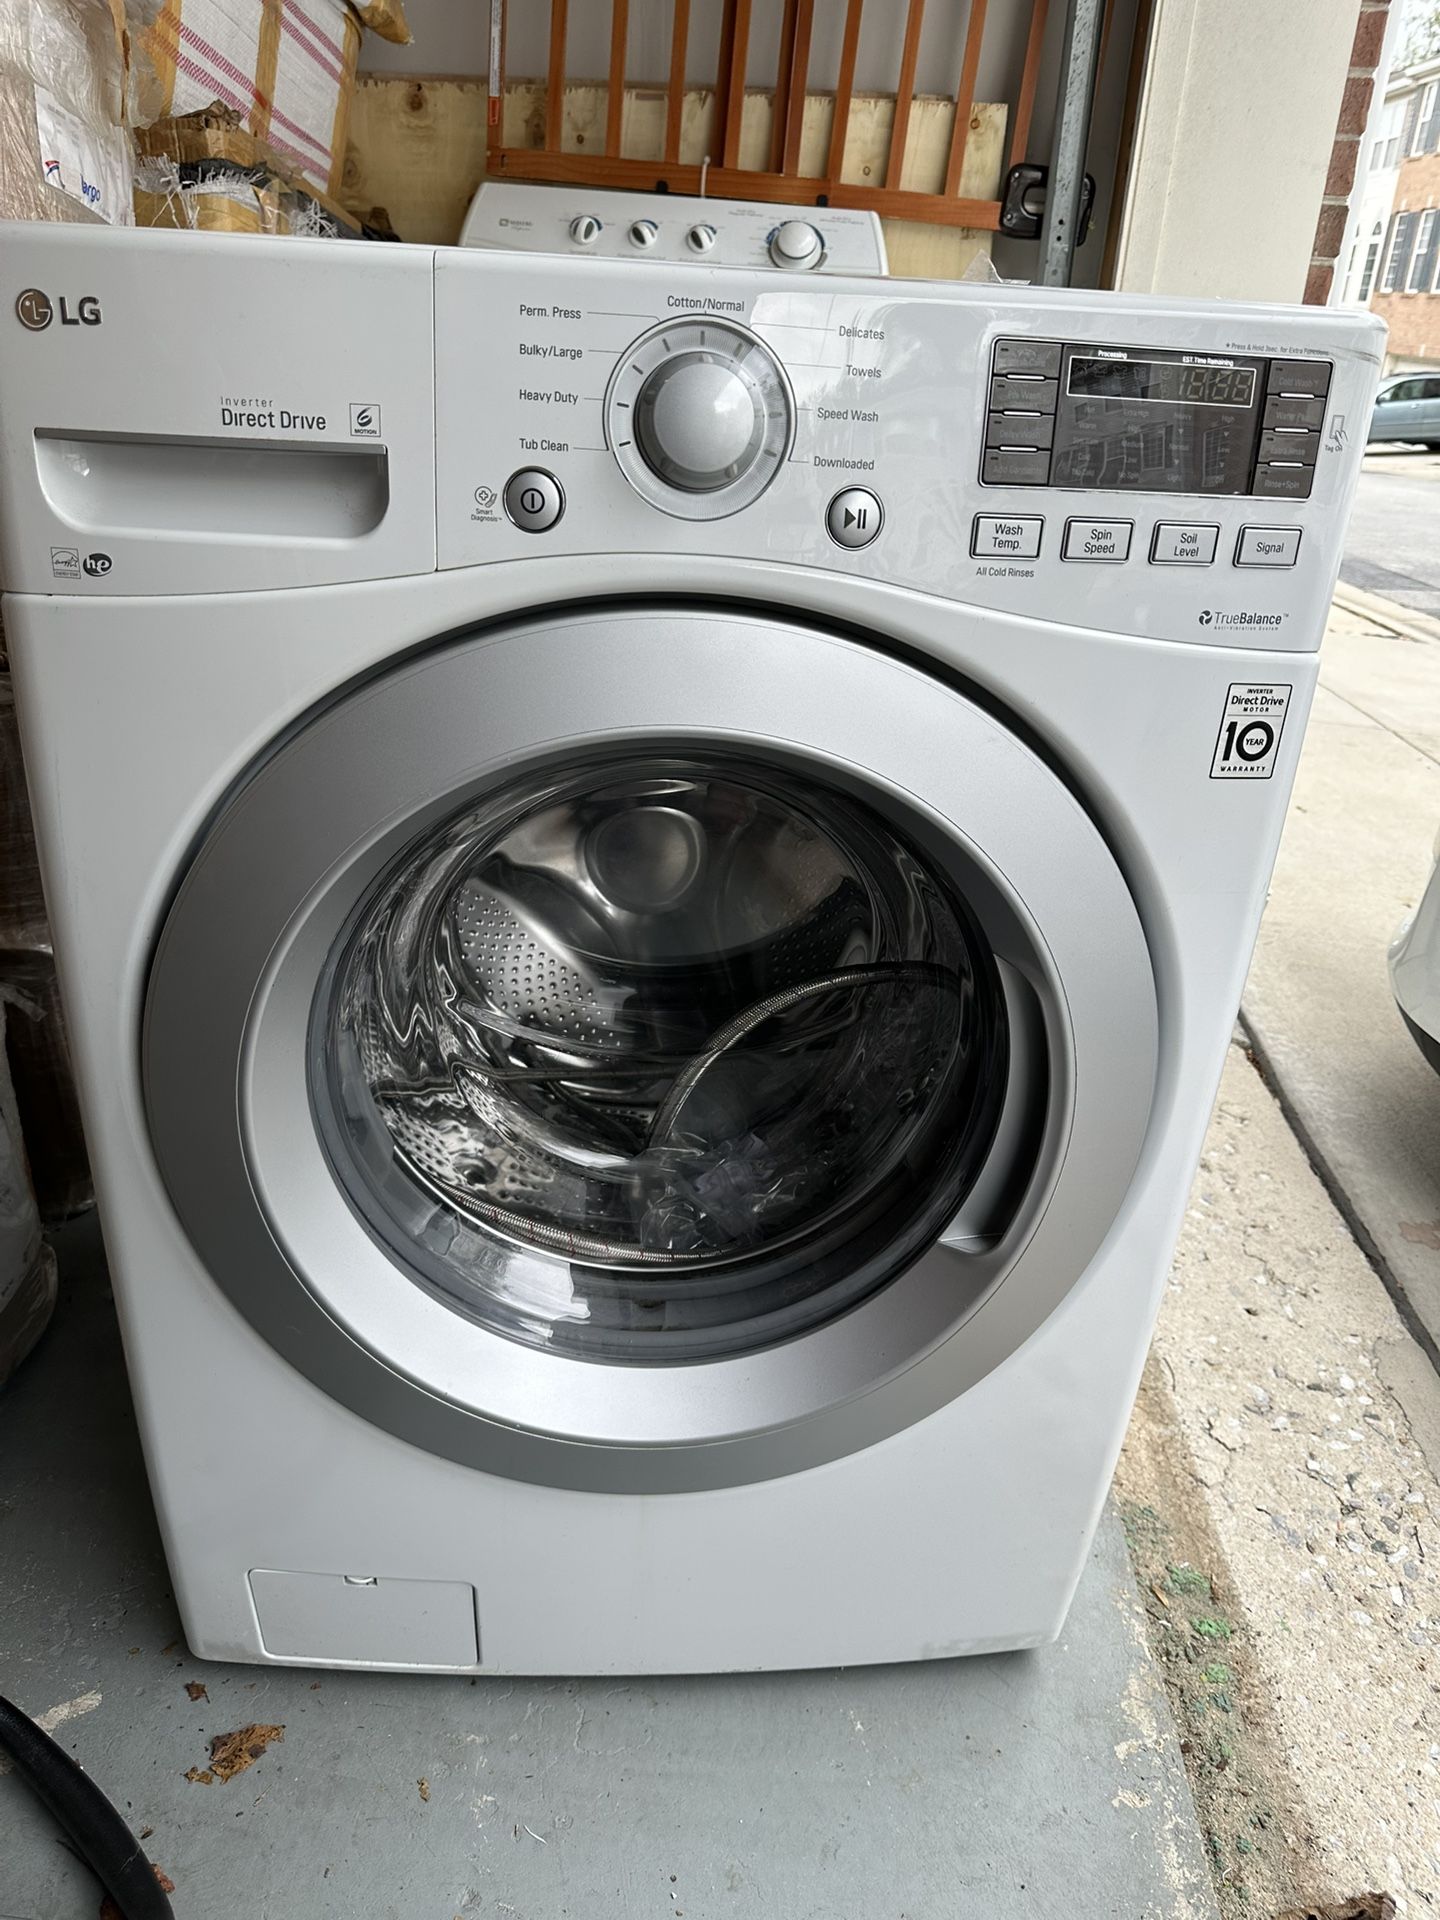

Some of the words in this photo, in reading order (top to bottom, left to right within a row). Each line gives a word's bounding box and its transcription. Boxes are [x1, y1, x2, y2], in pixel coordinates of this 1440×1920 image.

[667, 295, 745, 312] Cotton/Normal
[59, 296, 102, 326] LG
[519, 304, 550, 318] Perm.
[552, 306, 582, 320] Press
[839, 325, 885, 341] Delicates
[519, 344, 583, 360] Bulky/Large
[1231, 342, 1247, 351] Press
[1097, 349, 1128, 361] Processing
[1207, 357, 1234, 368] Remaining
[846, 364, 882, 378] Towels
[220, 396, 274, 408] Inverter
[519, 389, 552, 404] Heavy
[554, 391, 579, 405] Duty
[222, 408, 276, 428] Direct
[280, 411, 326, 430] Drive
[817, 407, 849, 422] Speed
[851, 409, 879, 423] Wash
[519, 438, 539, 450] Tub
[540, 439, 569, 452] Clean
[1325, 444, 1334, 453] Tag
[814, 455, 875, 471] Downloaded
[476, 507, 493, 515] Smart
[994, 523, 1024, 537] Wash
[1090, 528, 1113, 543] Spin
[992, 536, 1022, 551] Temp.
[1179, 532, 1198, 546] Soil
[1083, 541, 1116, 556] Speed
[1173, 544, 1199, 558] Level
[1256, 541, 1284, 556] Signal
[976, 566, 987, 577] All
[988, 567, 1007, 578] Cold
[1008, 567, 1035, 579] Rinses
[1231, 695, 1258, 705] Direct
[1260, 696, 1284, 706] Drive
[1222, 720, 1275, 762] 10
[1245, 738, 1265, 746] YEAR
